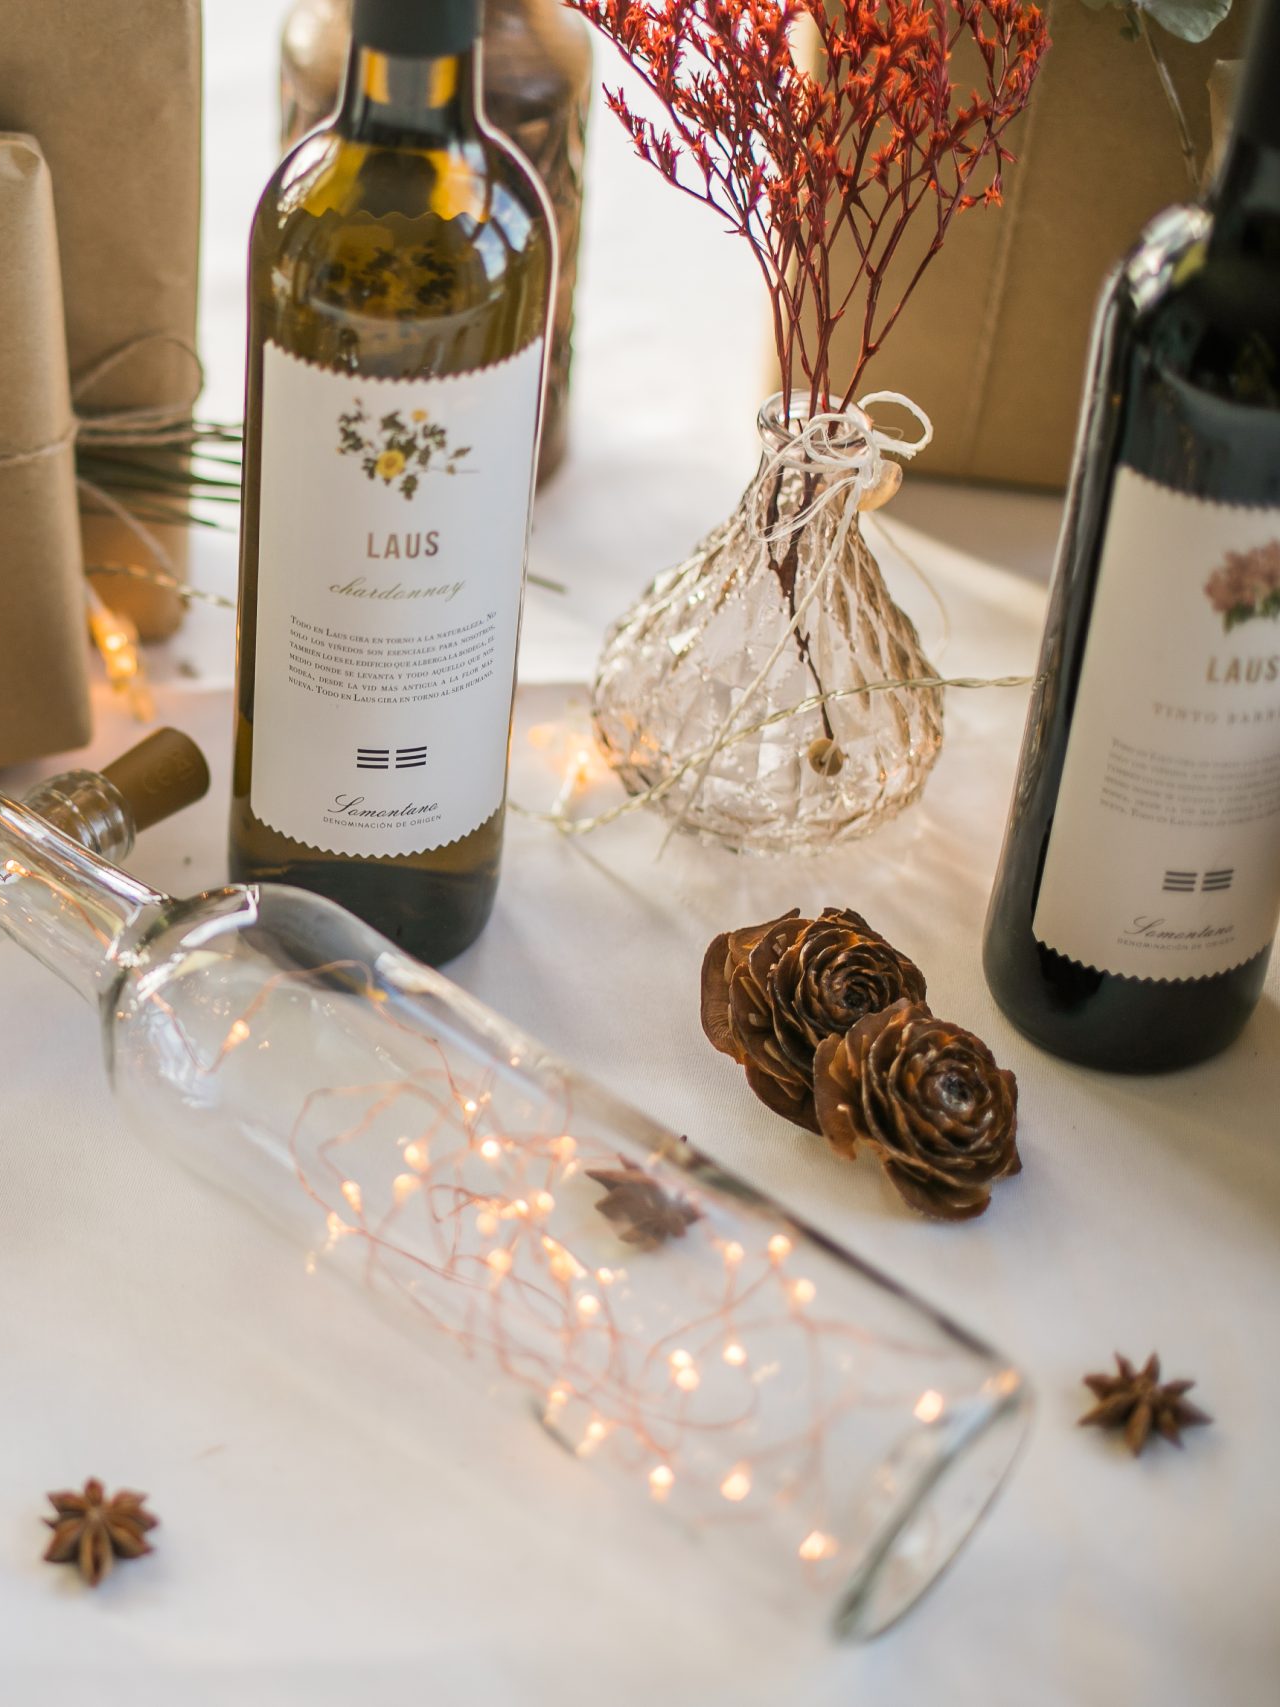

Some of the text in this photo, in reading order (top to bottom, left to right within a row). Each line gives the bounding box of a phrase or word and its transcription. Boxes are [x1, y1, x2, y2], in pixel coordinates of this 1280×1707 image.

[366, 530, 440, 559] LAUS
[328, 577, 466, 602] chardonnay
[290, 629, 308, 641] SOLO
[311, 637, 325, 647] LOS
[387, 646, 436, 656] ESENCIALES
[439, 641, 458, 651] PARA
[313, 626, 323, 634] EN
[349, 635, 369, 644] GIRA
[322, 653, 332, 661] LO
[334, 656, 343, 664] ES
[344, 658, 354, 666] EL
[356, 660, 392, 668] EDIFICIO
[394, 661, 412, 669] QUE
[412, 656, 447, 667] ALBERGA
[487, 635, 495, 643] EL
[289, 652, 312, 667] MEDIO
[314, 663, 341, 675] DONDE
[406, 671, 429, 679] TODO
[431, 661, 466, 677] AQUELLO
[467, 654, 480, 666] QUE
[1206, 655, 1280, 683] LAUS
[319, 676, 343, 688] DESDE
[347, 682, 358, 690] LA
[402, 681, 437, 691] ANTIGUA
[449, 675, 458, 683] LA
[461, 666, 479, 679] FLOR
[341, 693, 352, 701] EN
[411, 692, 440, 702] TORNO
[440, 689, 450, 697] AL
[451, 684, 464, 694] SER
[1152, 702, 1217, 724] TINTO
[327, 794, 440, 818] Somontano
[323, 816, 392, 829] DENOMINACIÓN
[410, 814, 442, 827] ORIGEN
[1123, 915, 1234, 939] Somontano
